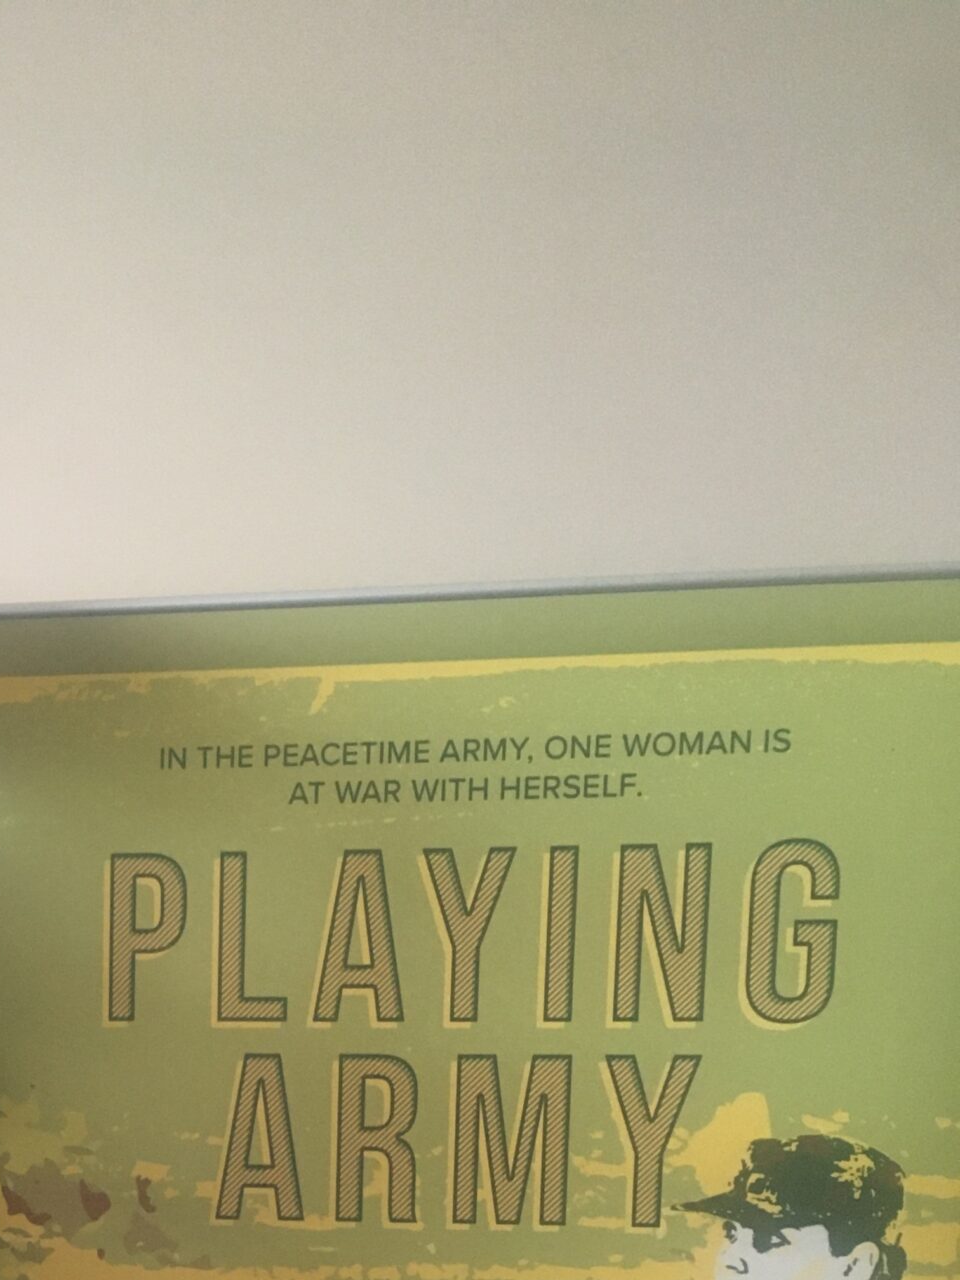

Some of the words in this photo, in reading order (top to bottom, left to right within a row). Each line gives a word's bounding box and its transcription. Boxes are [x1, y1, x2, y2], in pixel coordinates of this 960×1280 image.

[159, 746, 187, 770] IN
[197, 745, 253, 769] THE
[264, 739, 430, 767] PEACETIME
[440, 737, 534, 764] ARMY,
[544, 734, 612, 760] ONE
[621, 729, 753, 758] WOMAN
[762, 728, 792, 754] IS
[288, 781, 325, 805] AT
[334, 779, 401, 804] WAR
[411, 777, 489, 802] WITH
[500, 773, 643, 800] HERSELF.
[102, 837, 840, 1030] PLAYING
[212, 1052, 703, 1232] ARMY
